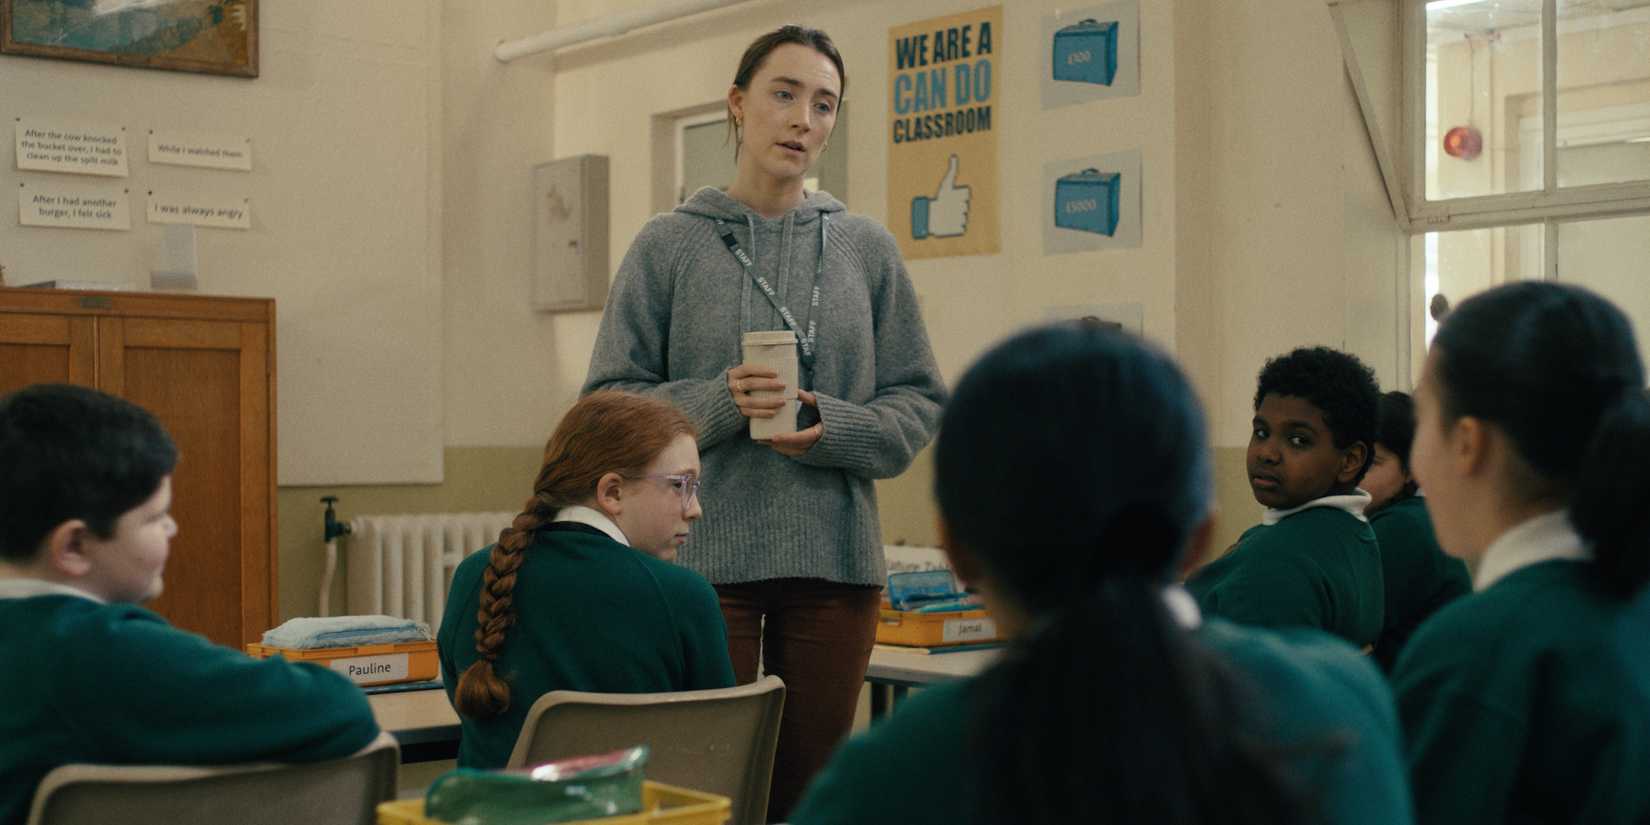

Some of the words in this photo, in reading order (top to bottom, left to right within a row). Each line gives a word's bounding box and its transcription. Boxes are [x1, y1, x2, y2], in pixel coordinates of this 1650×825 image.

[896, 34, 928, 70] WE
[932, 25, 971, 63] ARE
[976, 21, 992, 55] A
[895, 68, 947, 115] CAN
[956, 59, 991, 105] DO
[893, 105, 992, 144] CLASSROOM
[25, 128, 46, 138] After
[48, 130, 62, 139] the
[64, 133, 80, 141] cow
[82, 133, 118, 144] knocked
[21, 140, 35, 149] the
[37, 142, 65, 151] bucket
[67, 145, 88, 154] over,
[95, 147, 111, 155] had
[112, 147, 122, 155] to
[158, 143, 180, 154] While
[187, 147, 220, 158] watched
[26, 152, 49, 161] clean
[51, 155, 62, 163] up
[64, 154, 78, 162] the
[100, 157, 119, 166] milk
[33, 194, 55, 204] After
[62, 196, 80, 206] had
[82, 199, 117, 208] another
[39, 207, 71, 219] burger,
[78, 208, 93, 217] felt
[95, 209, 112, 219] sick
[160, 205, 179, 214] was
[182, 204, 215, 219] always
[217, 207, 243, 220] angry
[734, 248, 753, 267] STAFF
[757, 276, 775, 296] STAFF
[811, 285, 821, 307] STAFF
[780, 306, 798, 327] STAFF
[807, 320, 817, 343] STAFF
[958, 623, 982, 637] Jamal
[349, 662, 391, 676] Pauline
